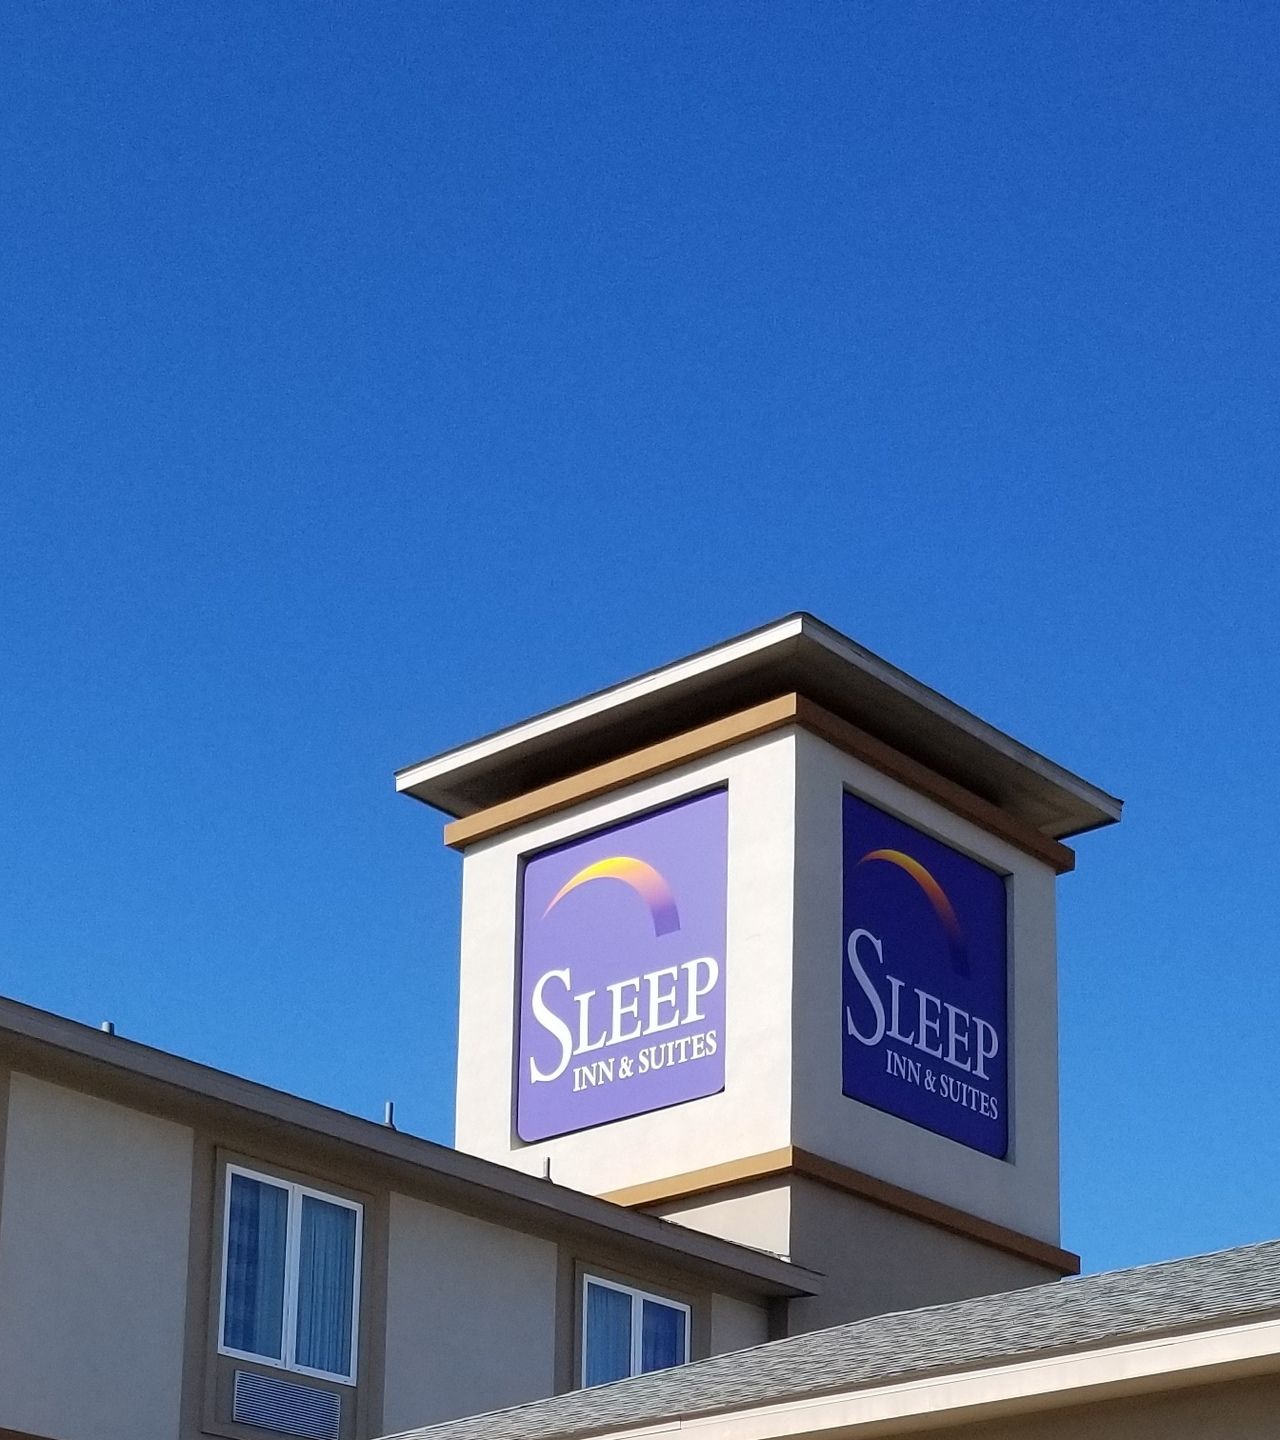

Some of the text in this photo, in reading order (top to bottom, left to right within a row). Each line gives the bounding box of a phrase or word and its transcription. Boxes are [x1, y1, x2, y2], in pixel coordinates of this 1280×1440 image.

[529, 957, 719, 1084] SLEEP
[847, 928, 999, 1080] SLEEP
[573, 1030, 717, 1092] INN & SUITES
[886, 1049, 998, 1120] INN & SUITES
